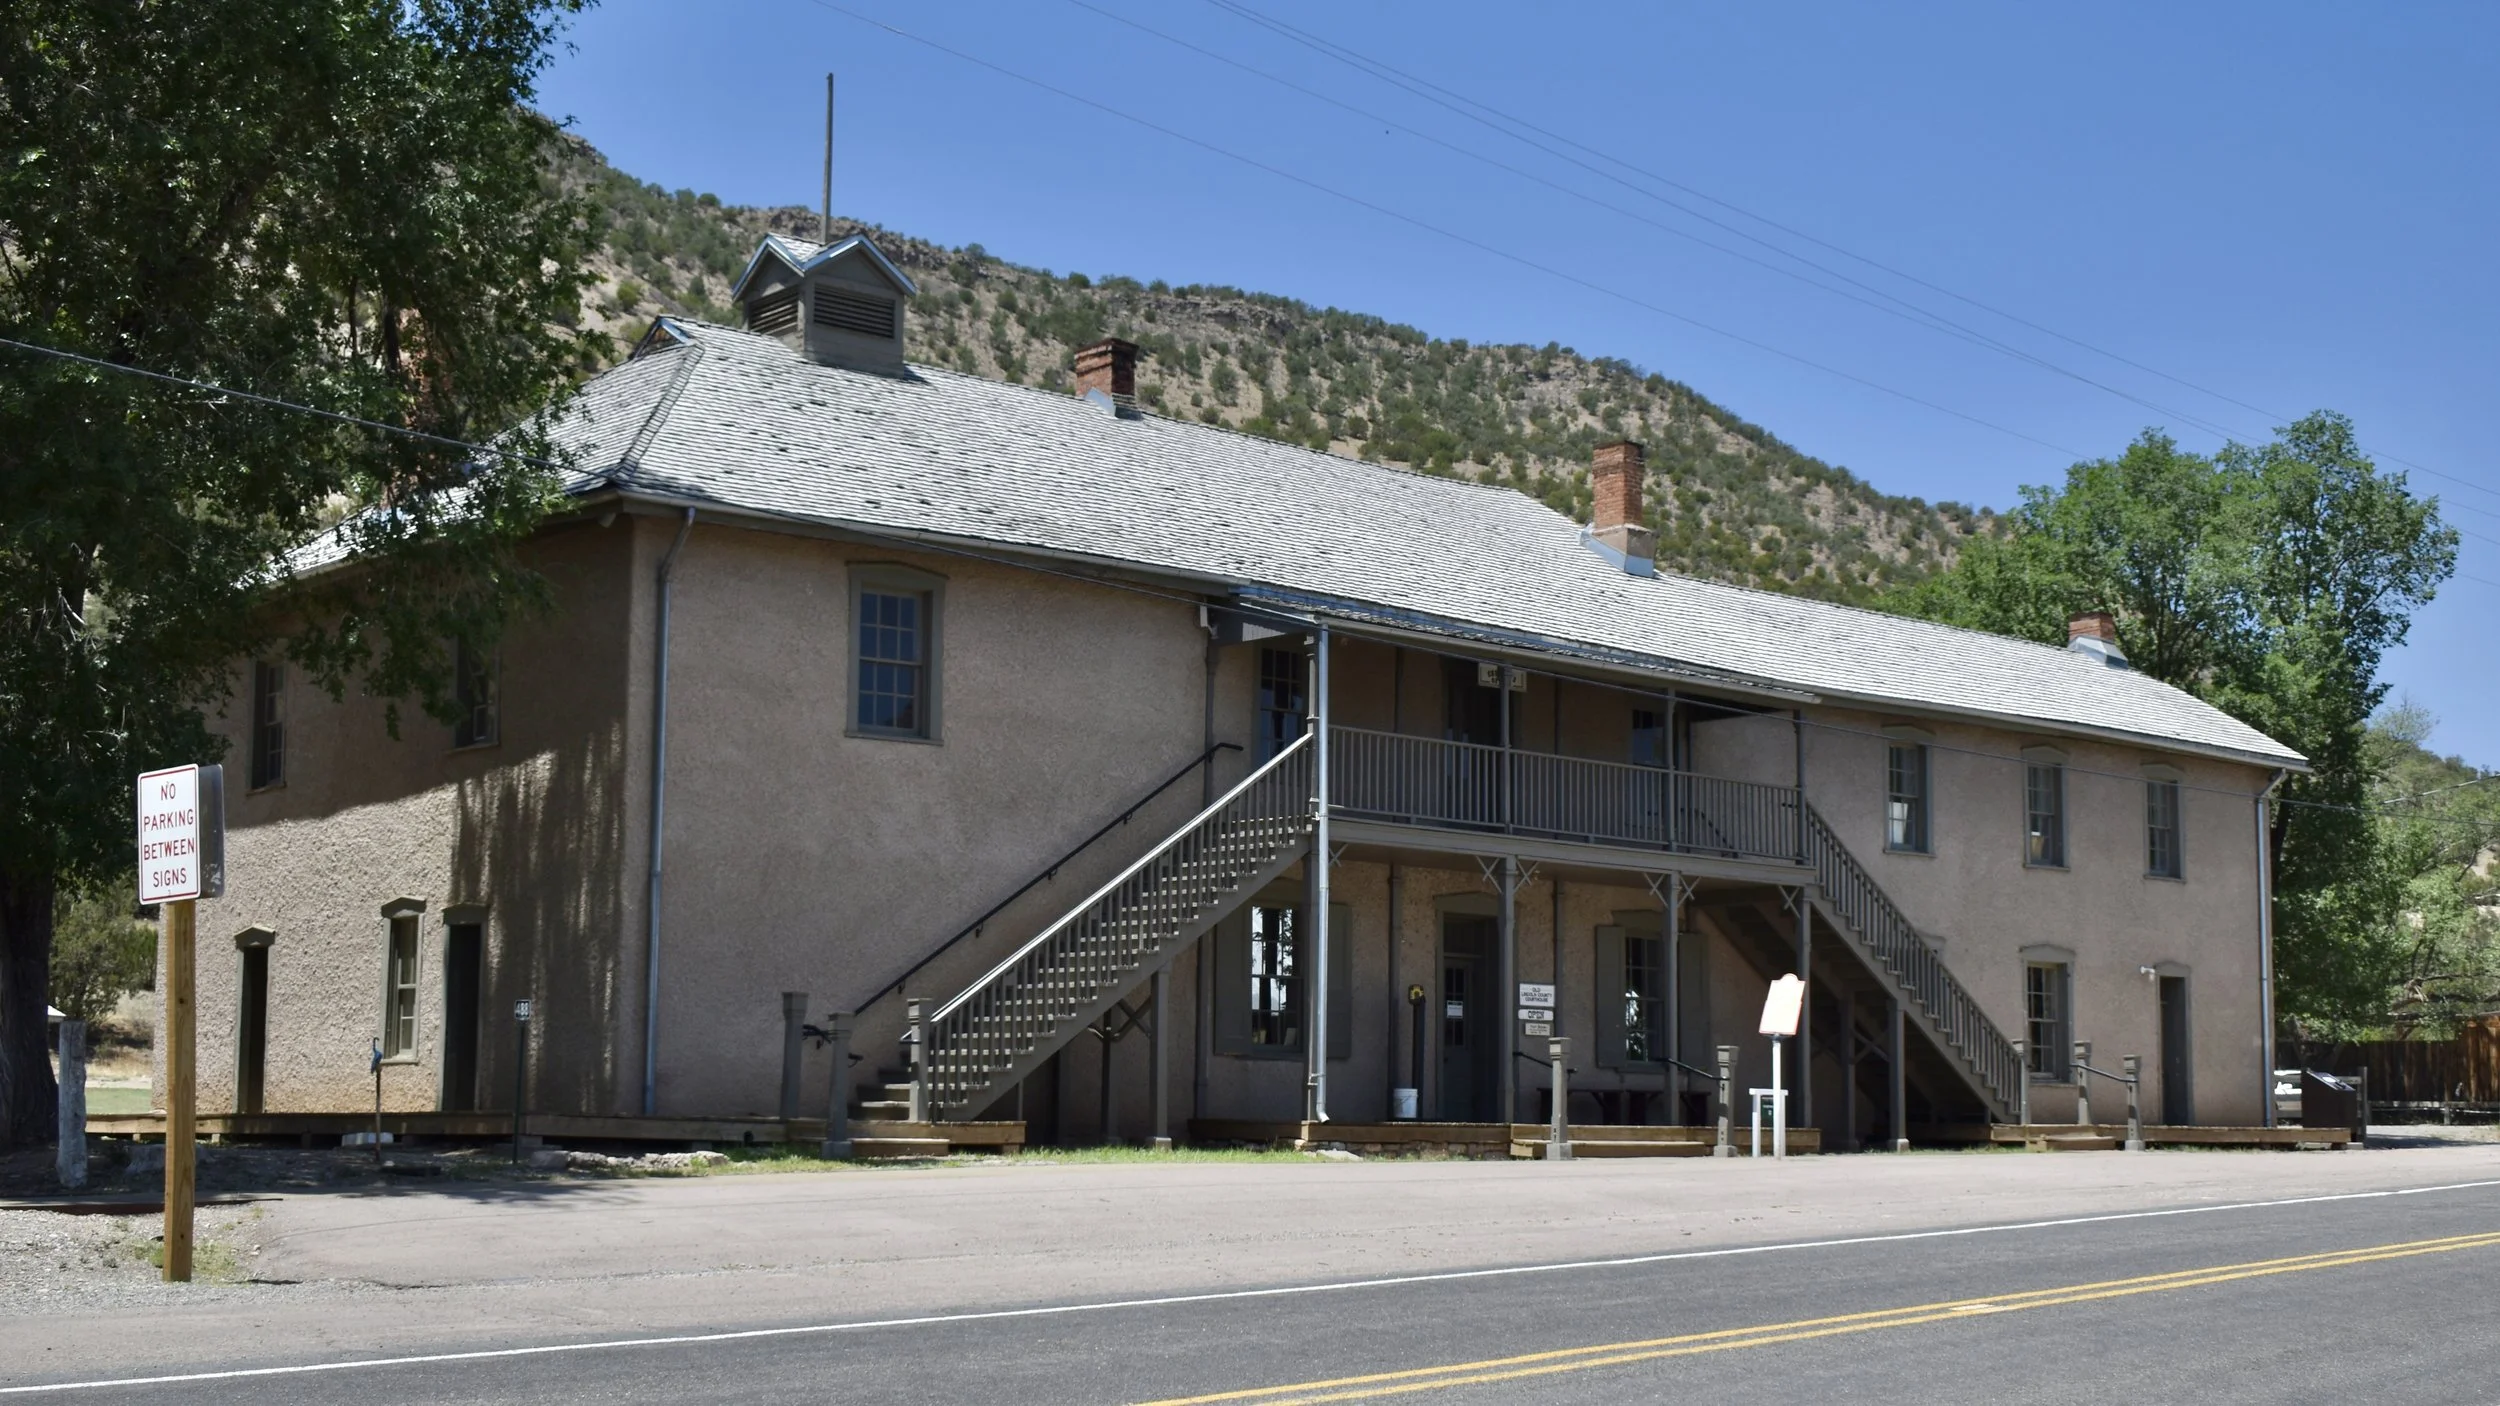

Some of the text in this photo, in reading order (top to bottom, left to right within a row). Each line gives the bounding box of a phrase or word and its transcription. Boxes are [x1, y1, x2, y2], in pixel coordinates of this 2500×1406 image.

[160, 782, 176, 801] NO
[143, 808, 194, 832] PARKING
[143, 837, 195, 861] BETWEEN
[152, 867, 187, 888] SIGNS
